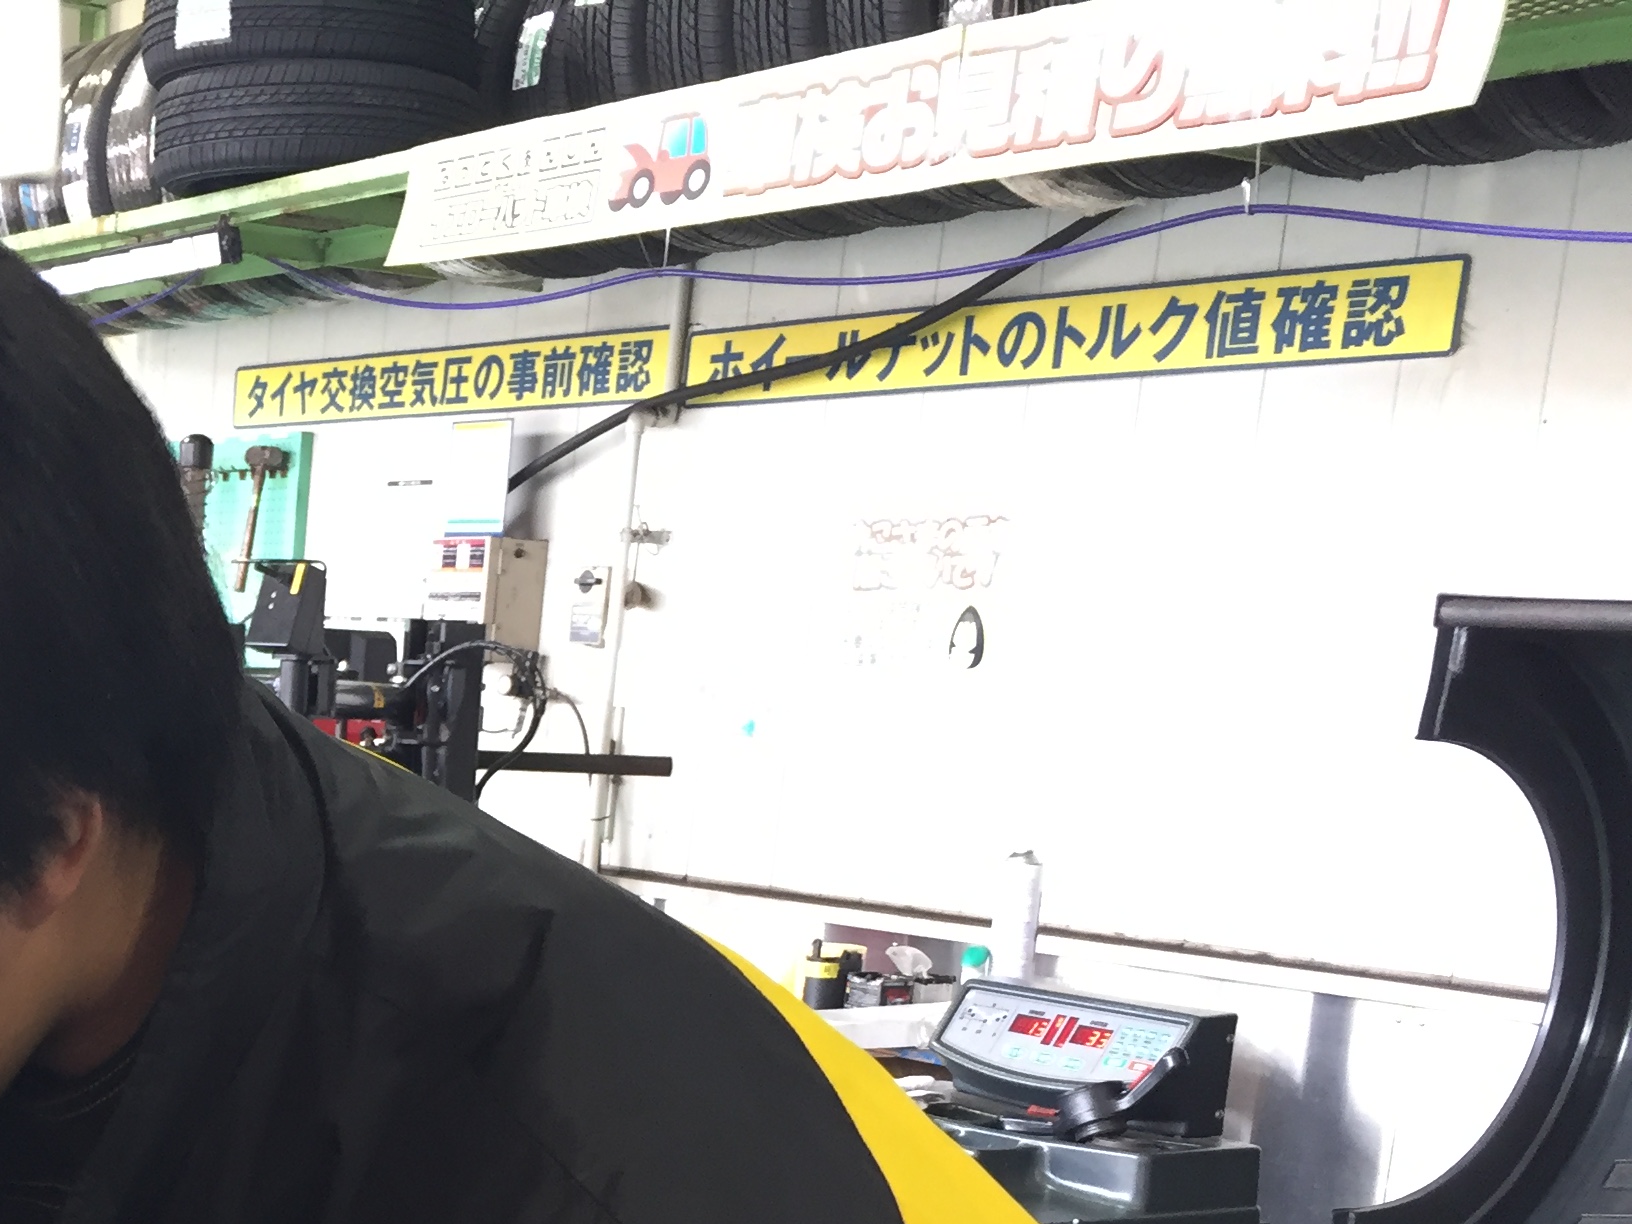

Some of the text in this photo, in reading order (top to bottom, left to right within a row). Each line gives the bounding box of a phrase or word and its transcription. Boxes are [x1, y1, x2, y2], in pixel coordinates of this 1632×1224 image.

[246, 338, 654, 418] タイヤ交換空気圧の事前確認
[707, 274, 1411, 394] ホイールナットのトルク値確認
